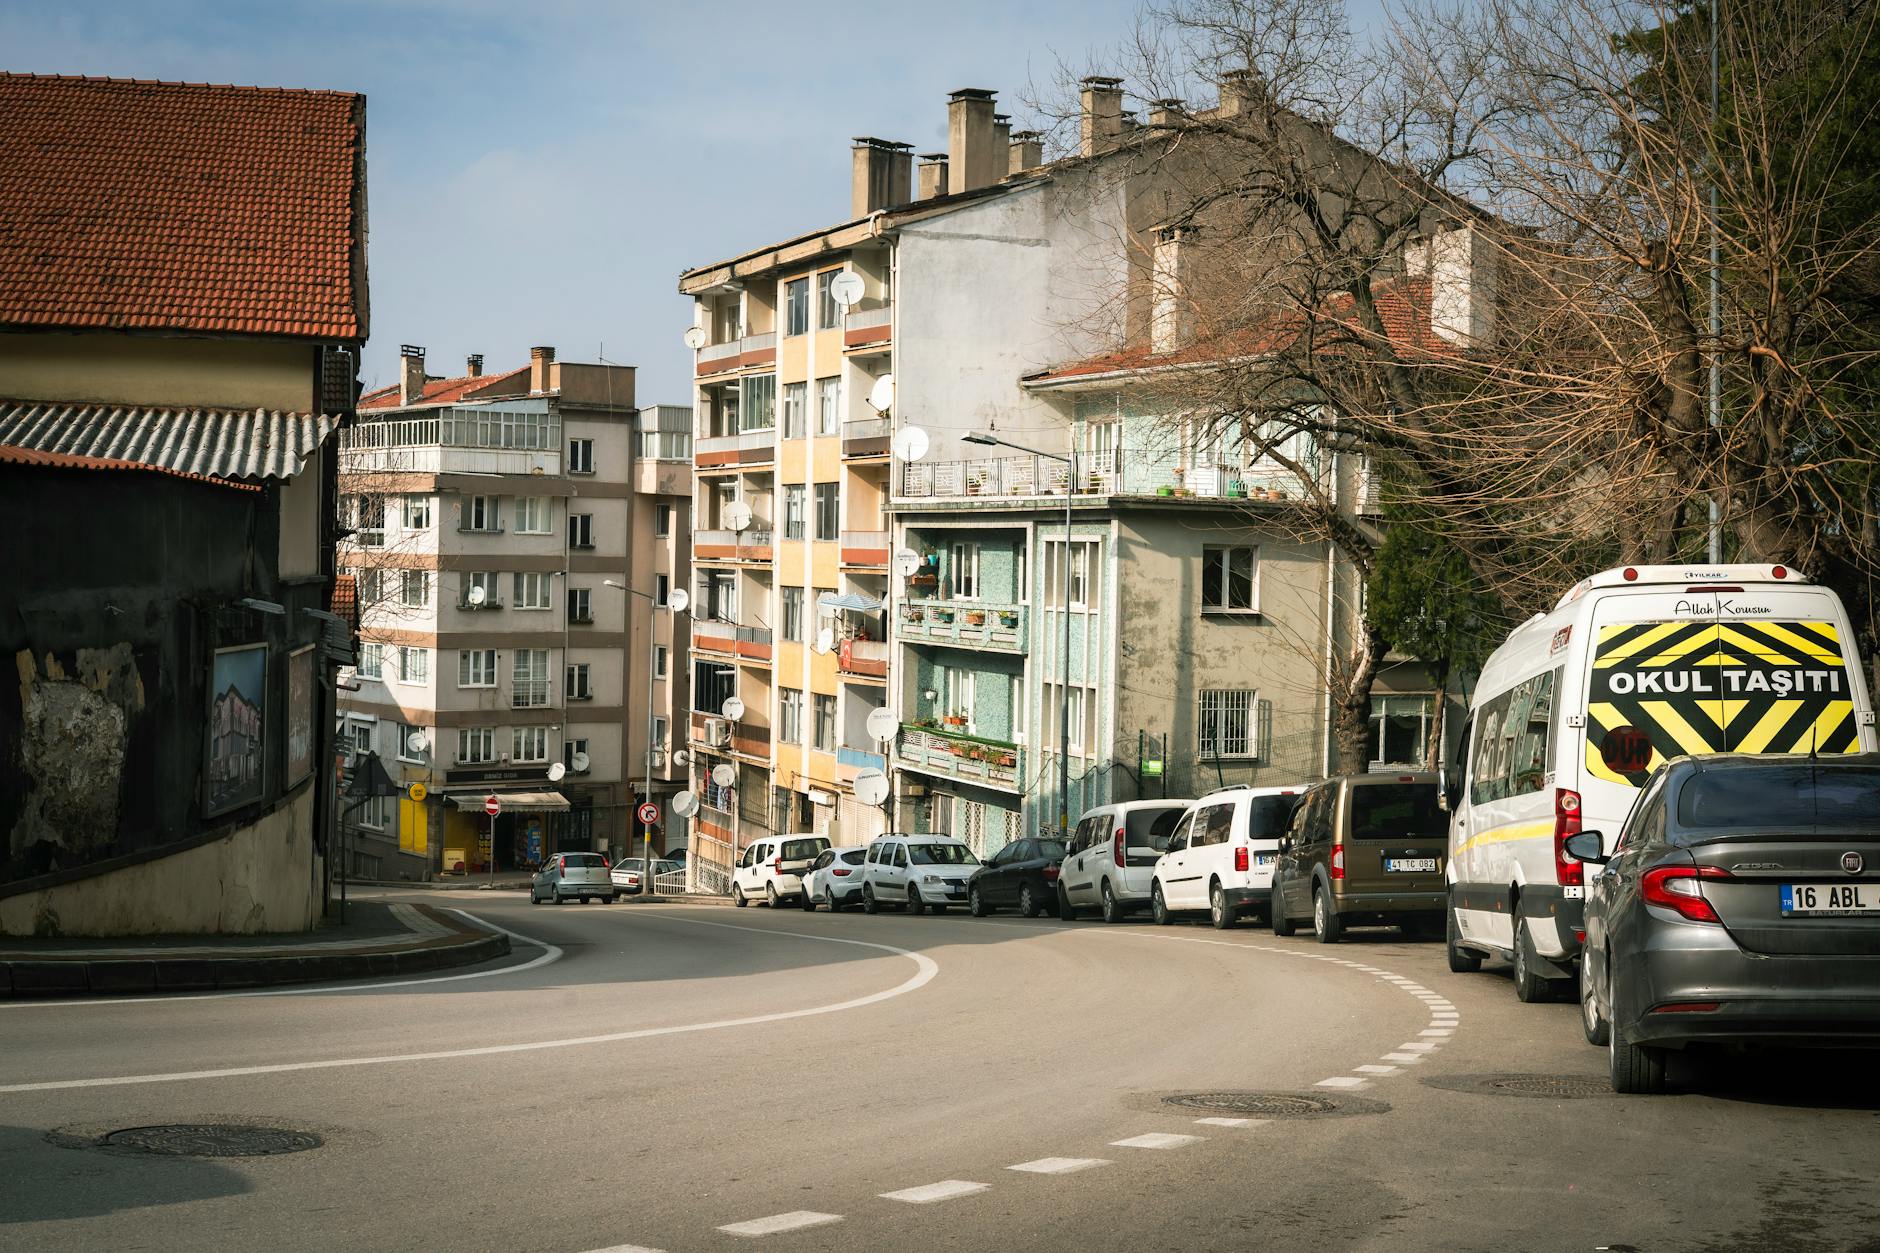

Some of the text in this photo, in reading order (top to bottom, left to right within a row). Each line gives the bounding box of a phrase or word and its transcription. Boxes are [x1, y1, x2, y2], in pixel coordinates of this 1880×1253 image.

[1673, 600, 1771, 615] Allah Korusun
[1608, 670, 1840, 698] OKUL TAŞITI
[1604, 735, 1649, 764] DUR
[1392, 860, 1434, 868] 41 TC 082
[1845, 857, 1859, 868] FIAT
[1795, 886, 1866, 908] 16 ABL
